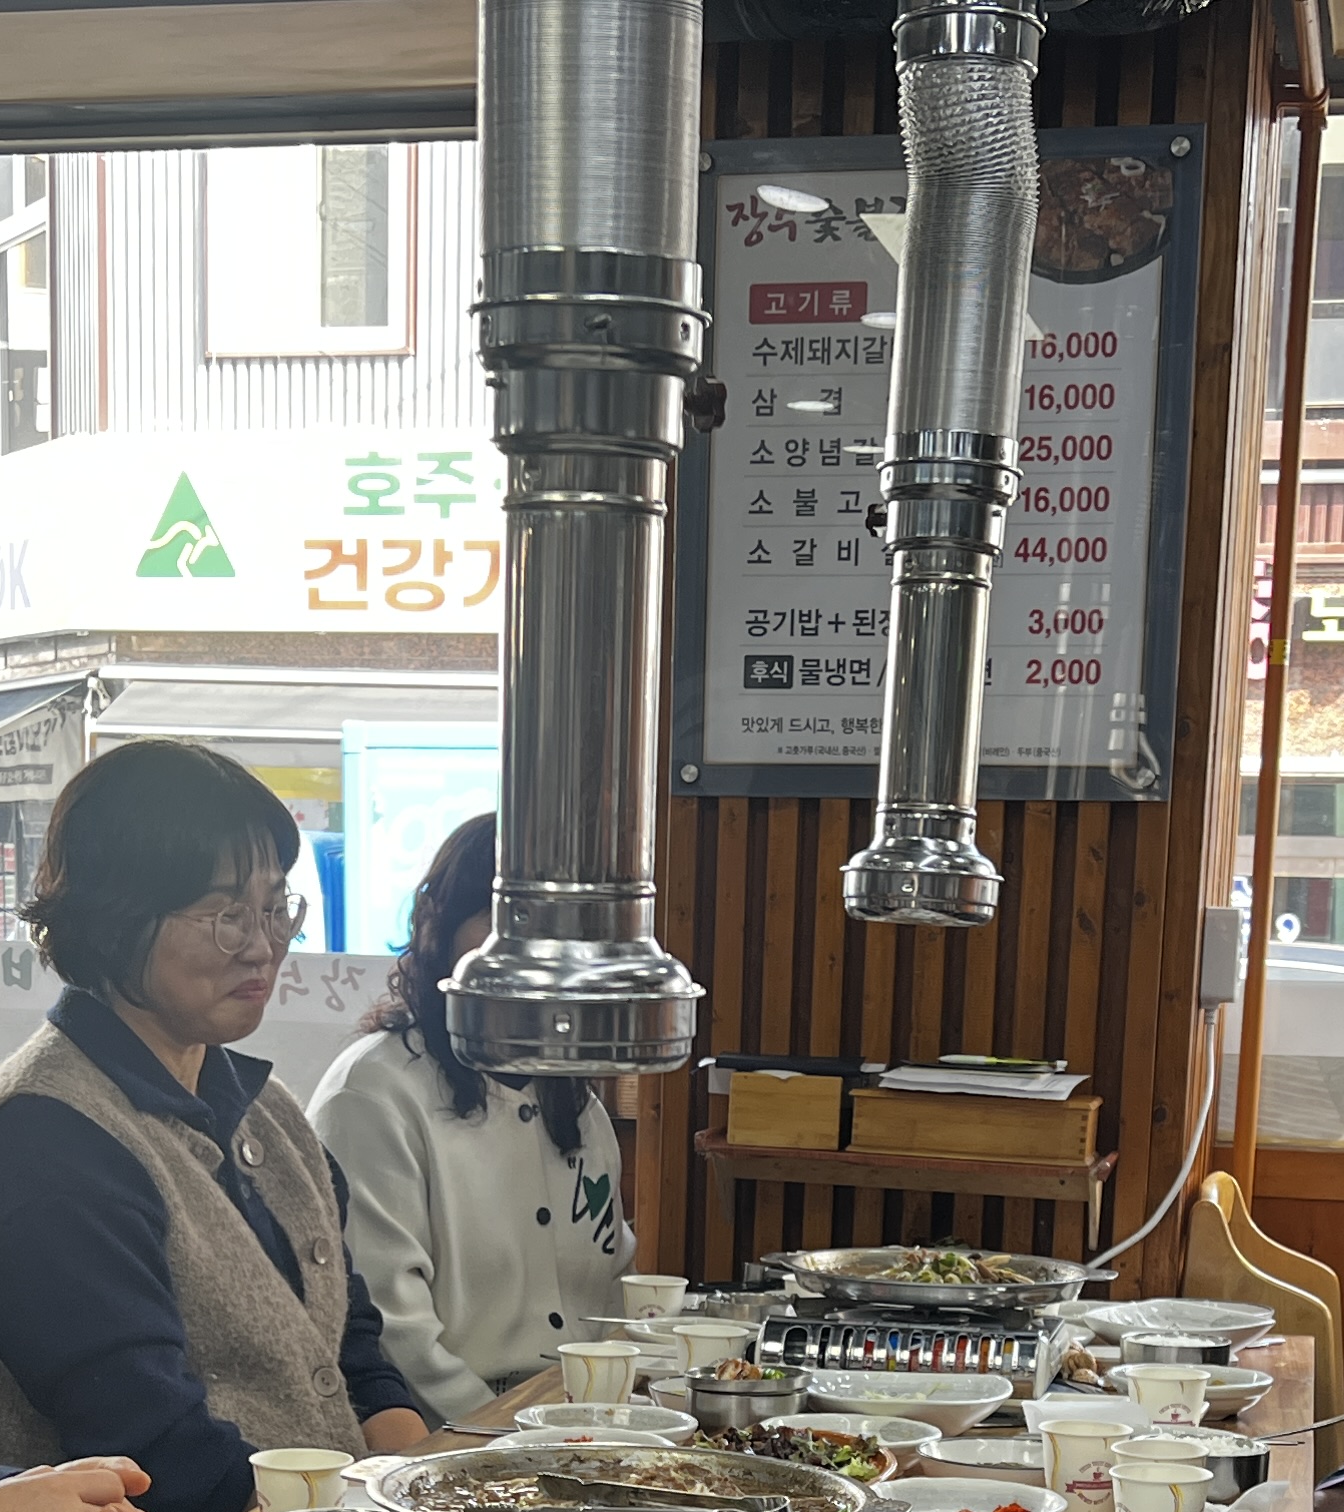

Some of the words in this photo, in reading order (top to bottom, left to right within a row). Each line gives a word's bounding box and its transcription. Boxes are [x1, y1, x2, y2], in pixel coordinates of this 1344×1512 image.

[764, 290, 852, 317] 고기류
[752, 336, 894, 367] 수제돼지갈
[1030, 331, 1118, 363] 16,000
[1024, 383, 1115, 415] 16,000
[1019, 435, 1113, 469] 25,000
[343, 451, 477, 519] 호주
[1021, 486, 1110, 516] 16,000
[1014, 537, 1107, 567] 44,000
[1028, 608, 1103, 639] 3,000
[750, 660, 788, 684] 후식
[1025, 658, 1102, 690] 2,000
[788, 717, 835, 735] 드시고,
